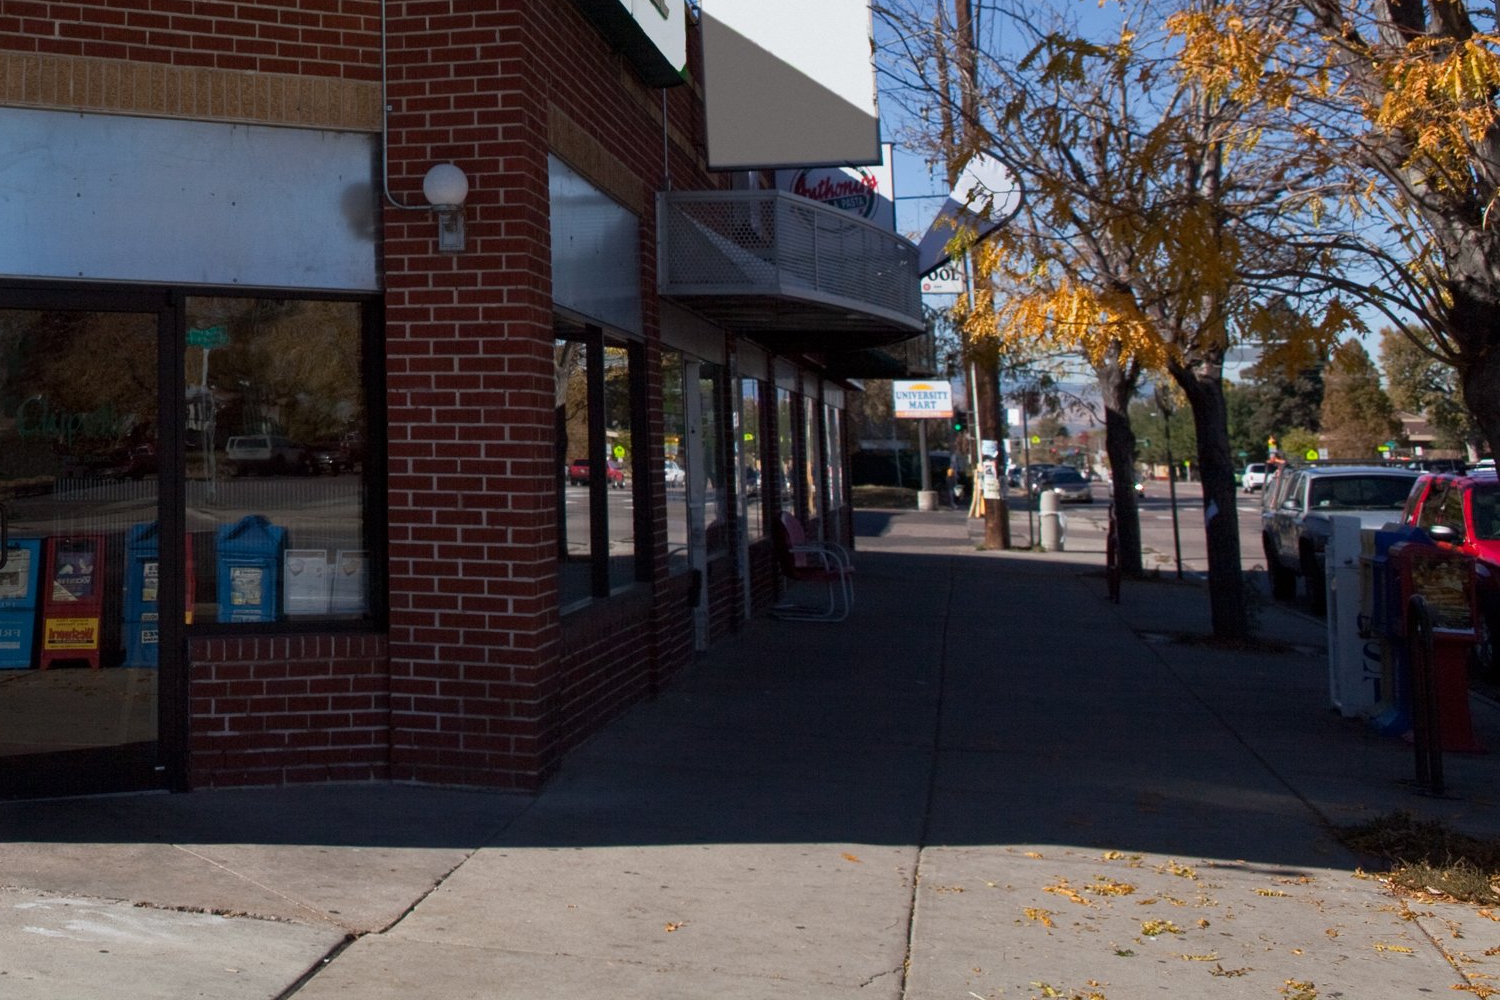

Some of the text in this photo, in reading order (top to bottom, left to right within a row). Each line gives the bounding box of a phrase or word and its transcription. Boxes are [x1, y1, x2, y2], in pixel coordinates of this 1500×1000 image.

[927, 269, 960, 281] OOL
[895, 391, 948, 400] UNIVERSITY
[908, 400, 937, 409] MART
